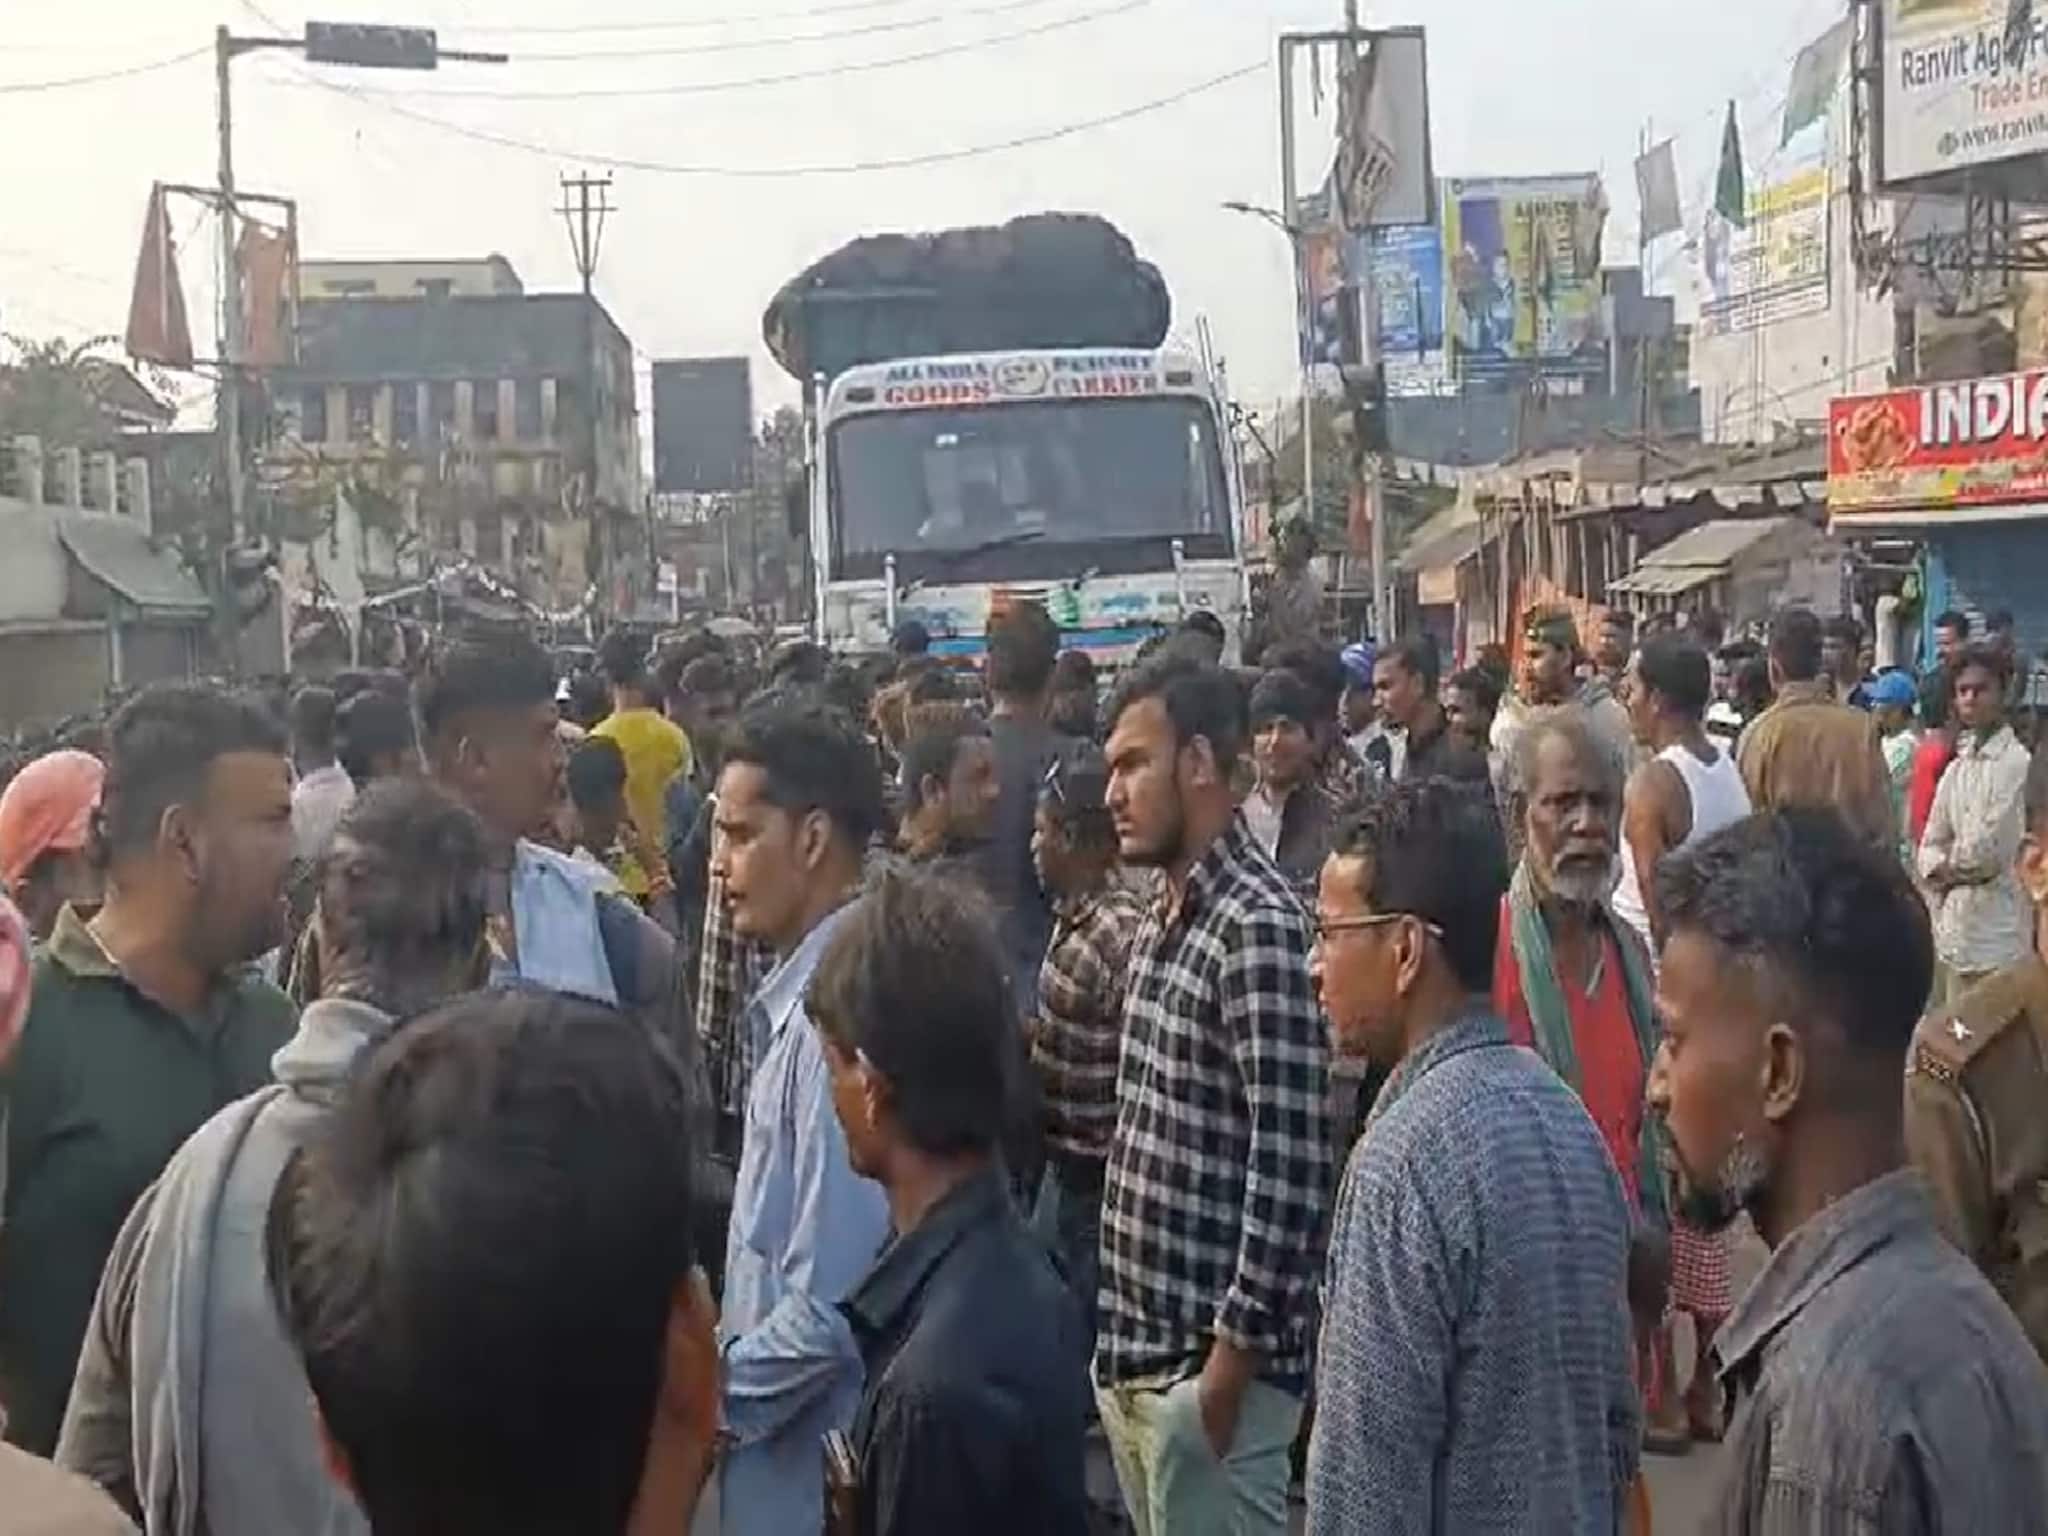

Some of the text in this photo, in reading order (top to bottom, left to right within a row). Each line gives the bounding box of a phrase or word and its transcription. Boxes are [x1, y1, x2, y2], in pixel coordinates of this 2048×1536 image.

[1901, 36, 1969, 90] Ranvit
[1970, 76, 2021, 112] Trade
[884, 381, 991, 405] GOODS
[1053, 373, 1158, 395] CARRIER
[886, 365, 923, 382] ALL
[926, 362, 989, 380] INDIA
